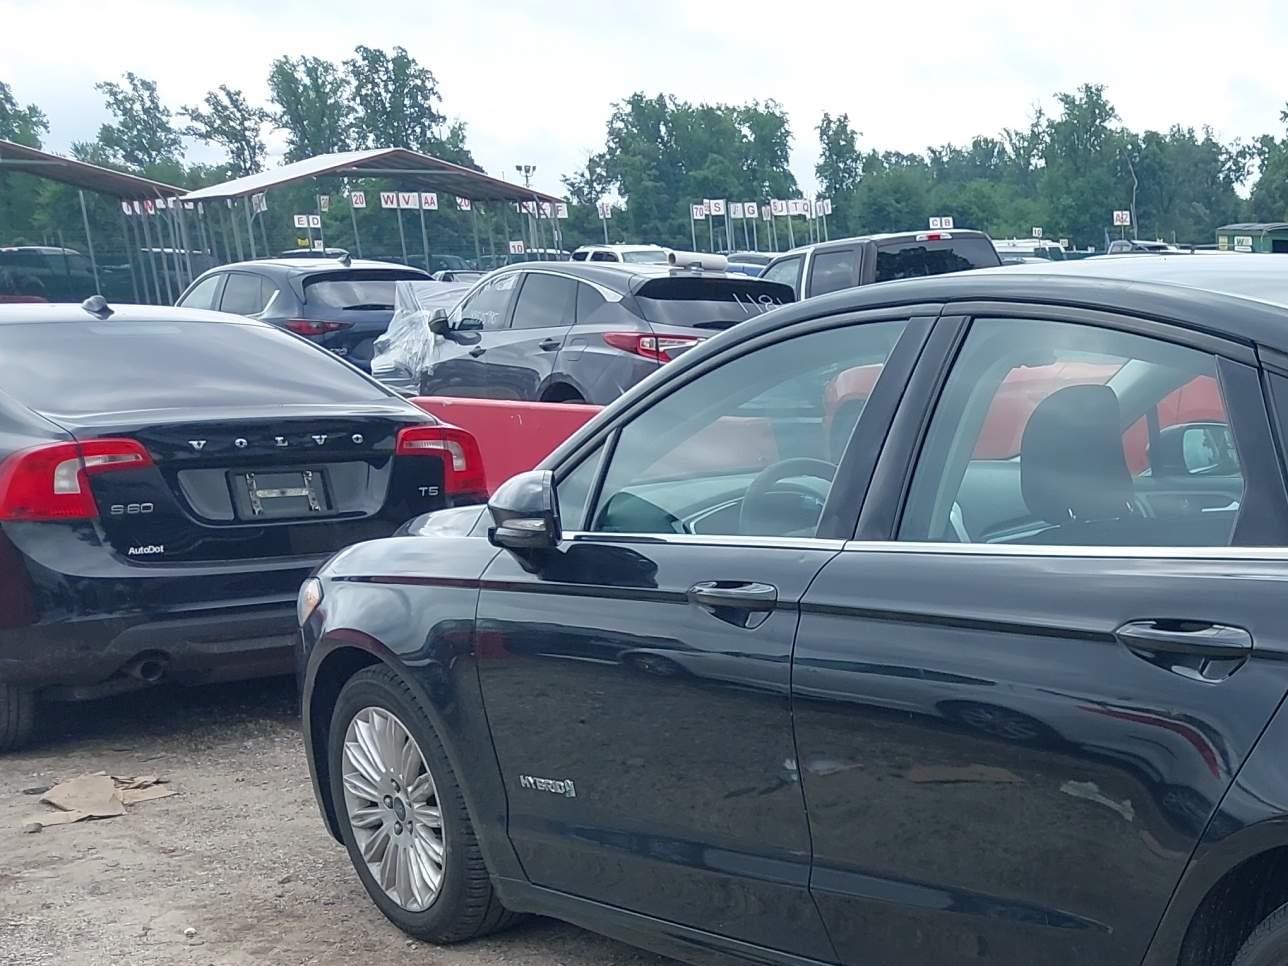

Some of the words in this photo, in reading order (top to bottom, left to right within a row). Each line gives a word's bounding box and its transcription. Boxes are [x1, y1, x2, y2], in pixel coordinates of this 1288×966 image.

[353, 194, 364, 205] 20
[188, 433, 364, 450] VOLVO
[417, 486, 440, 497] T5
[110, 502, 154, 515] S60
[127, 545, 164, 555] AutoDot
